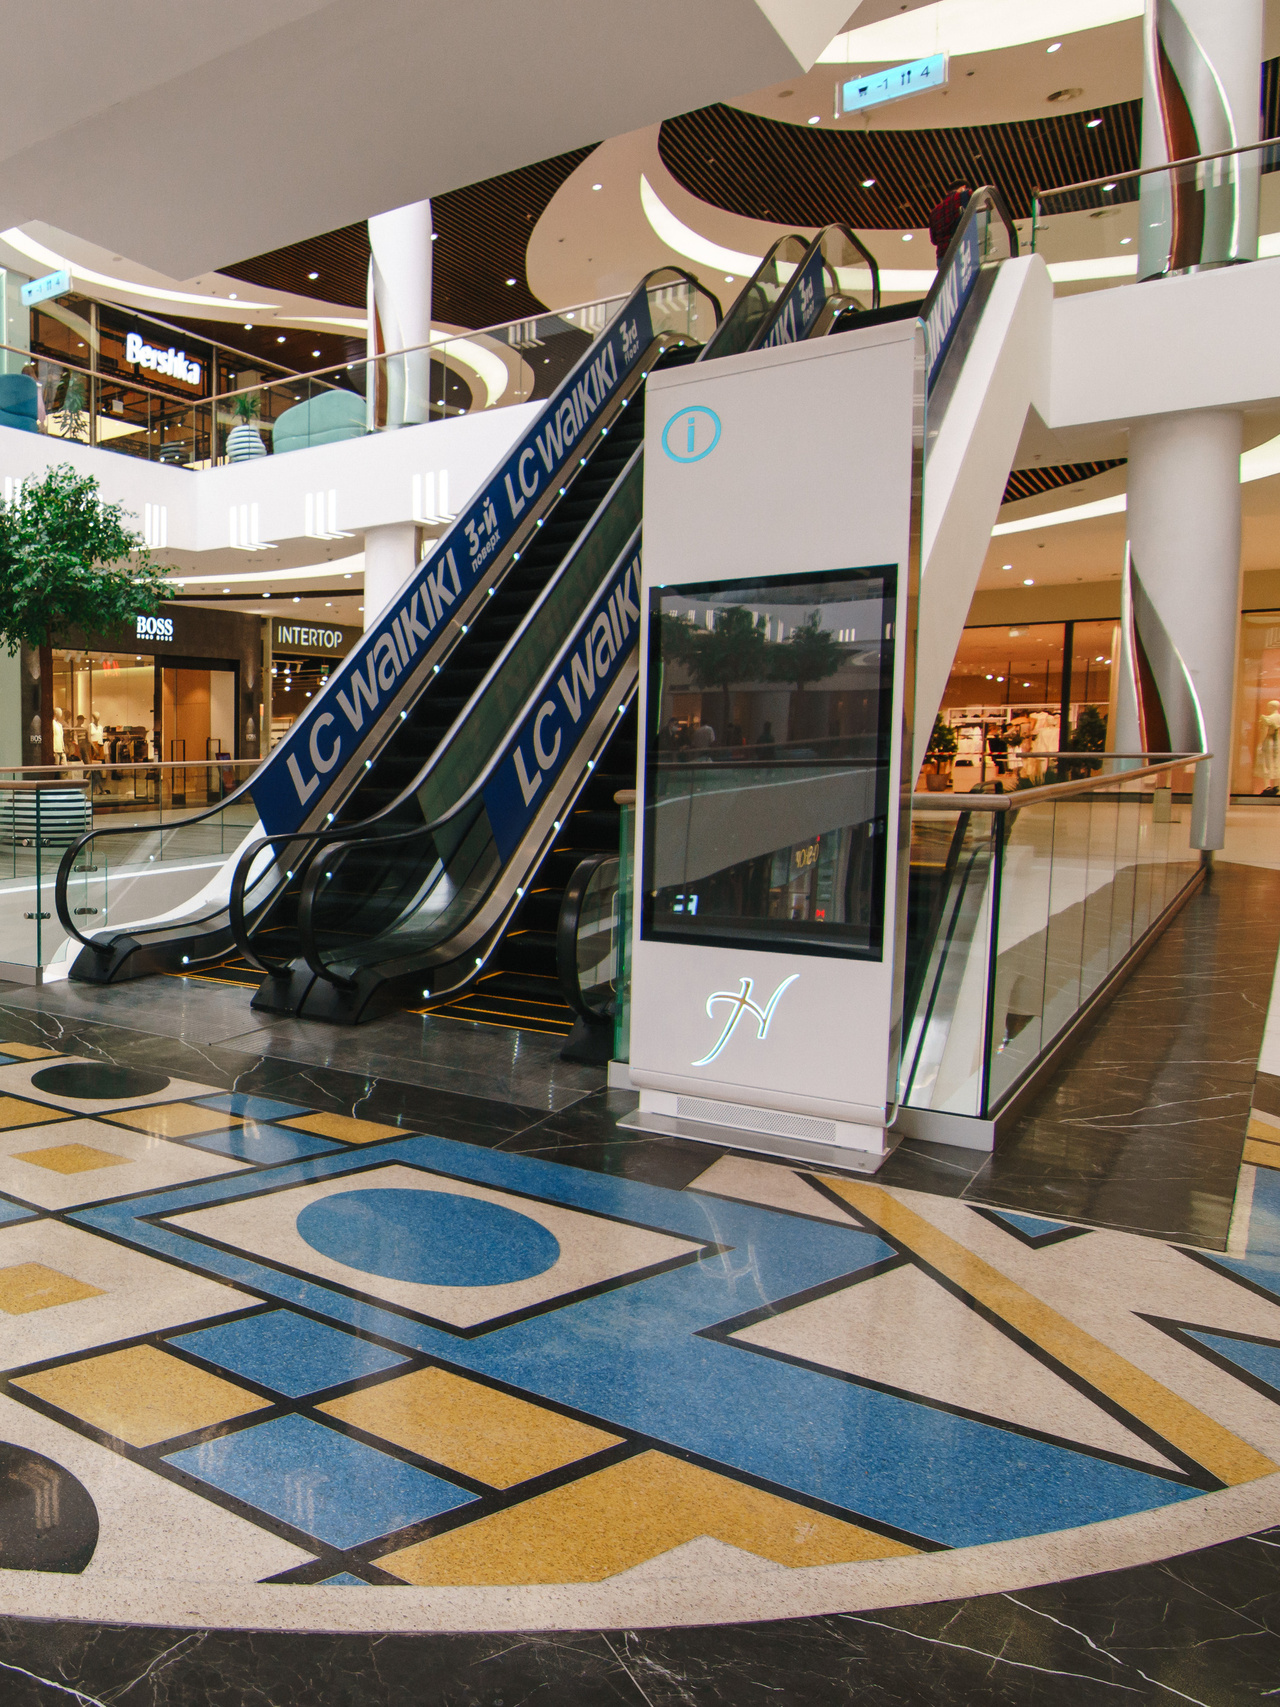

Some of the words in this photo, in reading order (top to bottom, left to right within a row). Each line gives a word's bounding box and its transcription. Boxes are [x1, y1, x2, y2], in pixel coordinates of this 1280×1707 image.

[920, 65, 930, 77] 4
[619, 318, 638, 352] 3rd
[126, 332, 201, 385] Bershka
[504, 447, 539, 520] LC
[464, 496, 498, 557] 3-й
[471, 529, 501, 573] поверх
[136, 615, 174, 636] BOSS
[278, 625, 343, 648] INTERTOP
[30, 734, 42, 742] BOS
[286, 712, 341, 806] LC
[513, 700, 561, 807] LC
